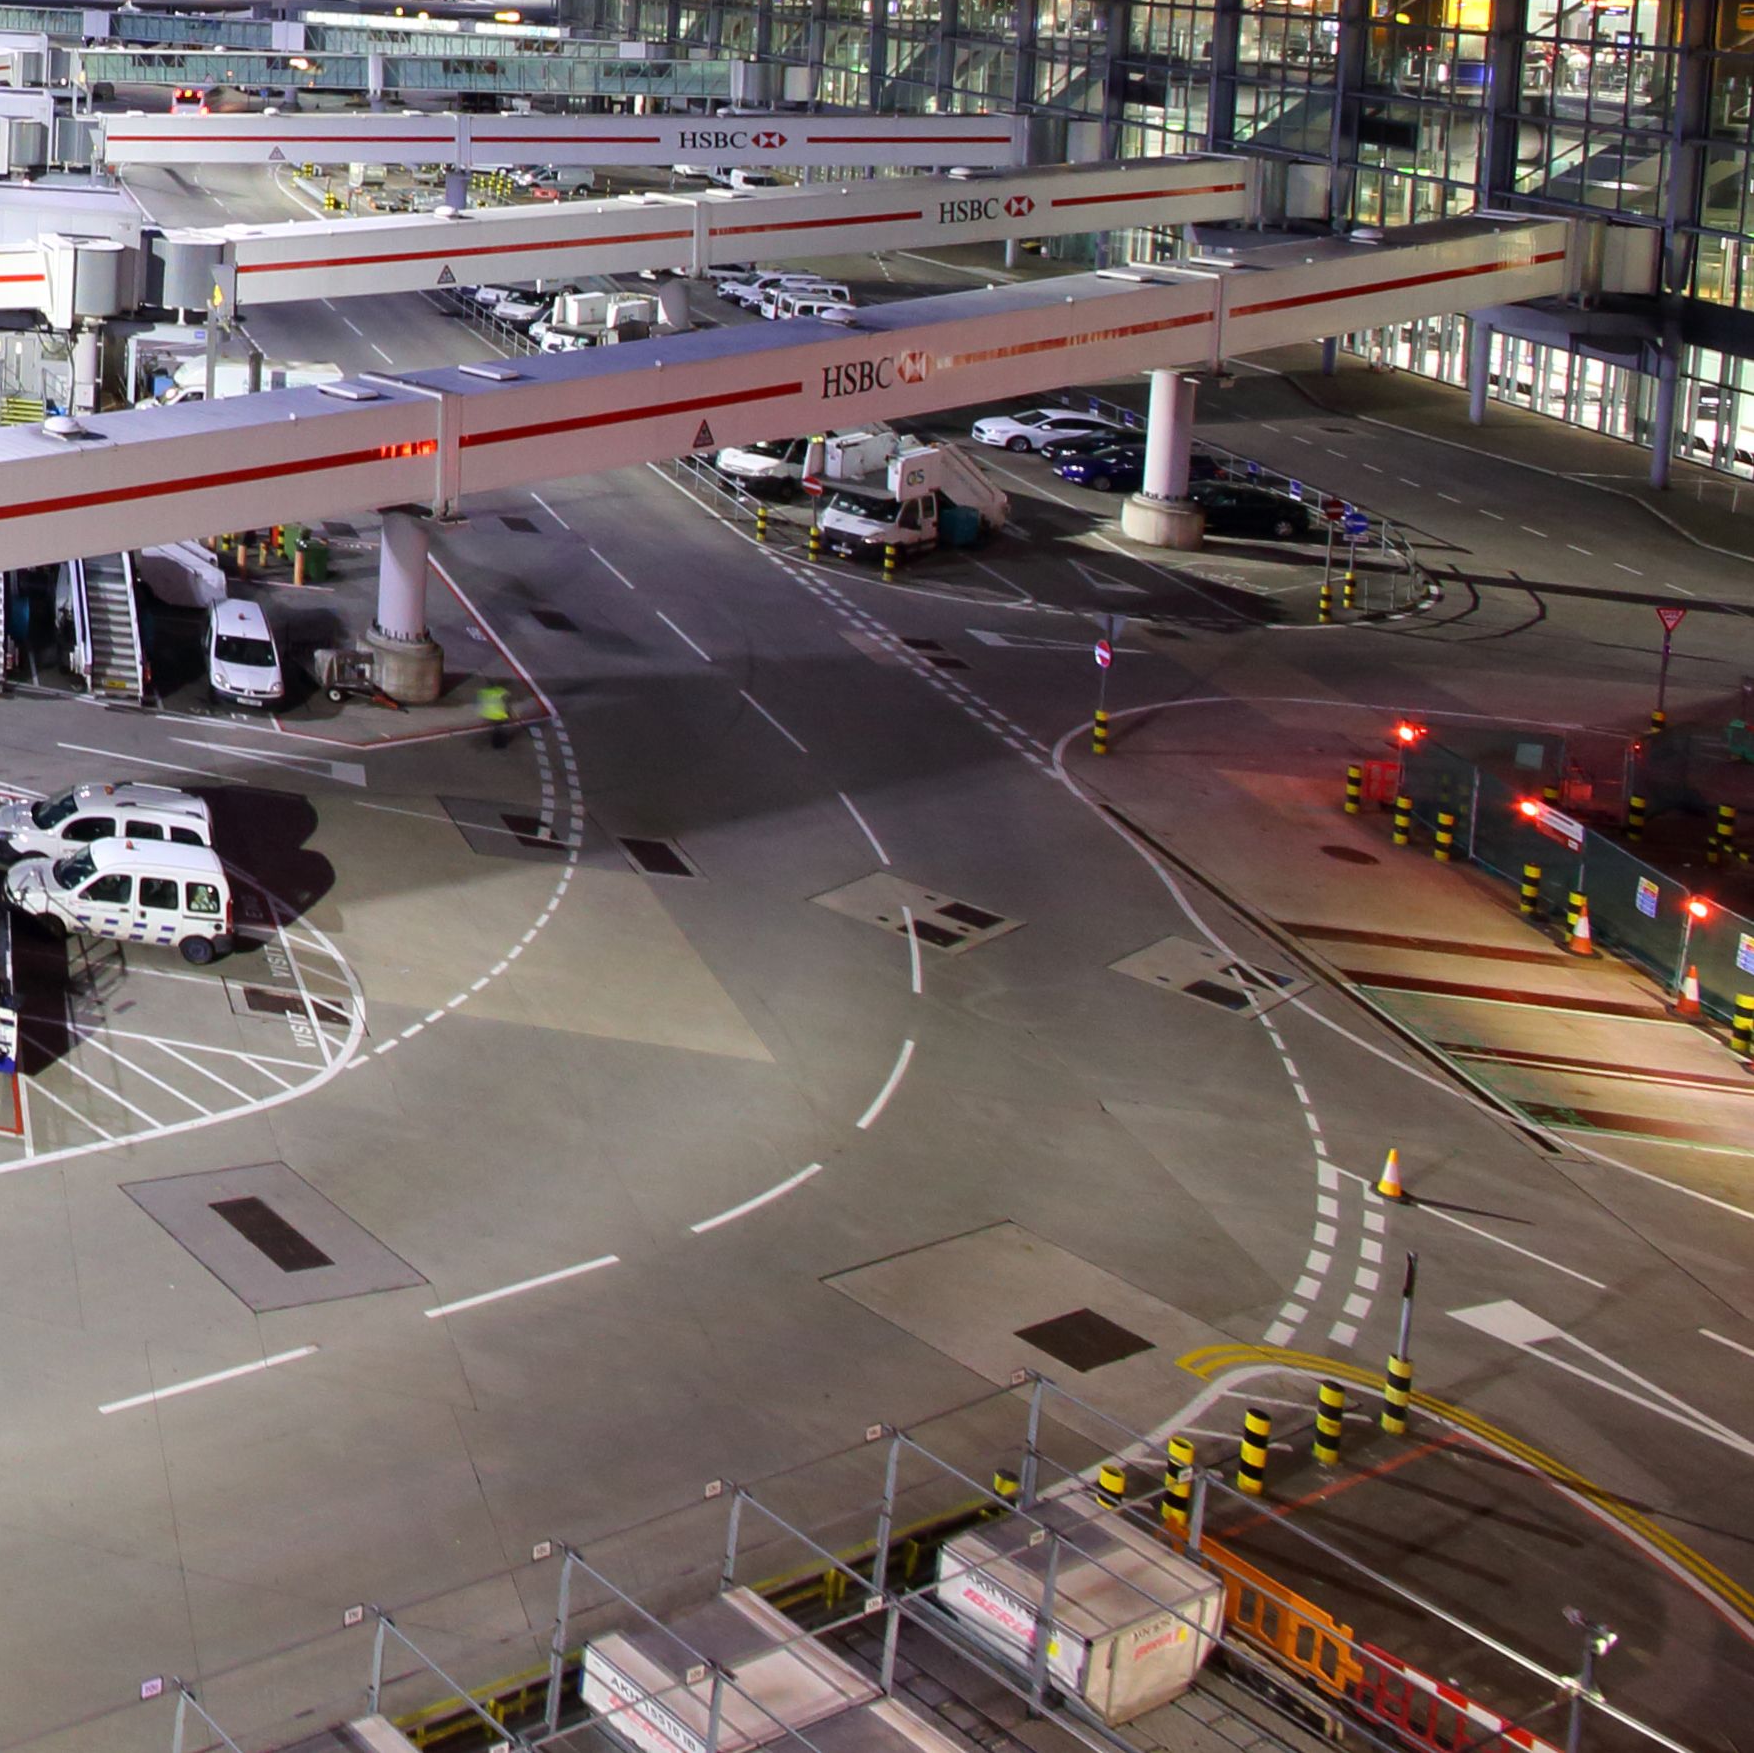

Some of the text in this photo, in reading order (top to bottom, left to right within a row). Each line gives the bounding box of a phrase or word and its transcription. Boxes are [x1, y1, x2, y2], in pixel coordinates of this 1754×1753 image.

[678, 131, 747, 148] HSBC
[938, 198, 999, 224] HSBC
[821, 358, 892, 400] HSBC
[264, 945, 291, 977] VISIT
[286, 1010, 316, 1047] VISIT
